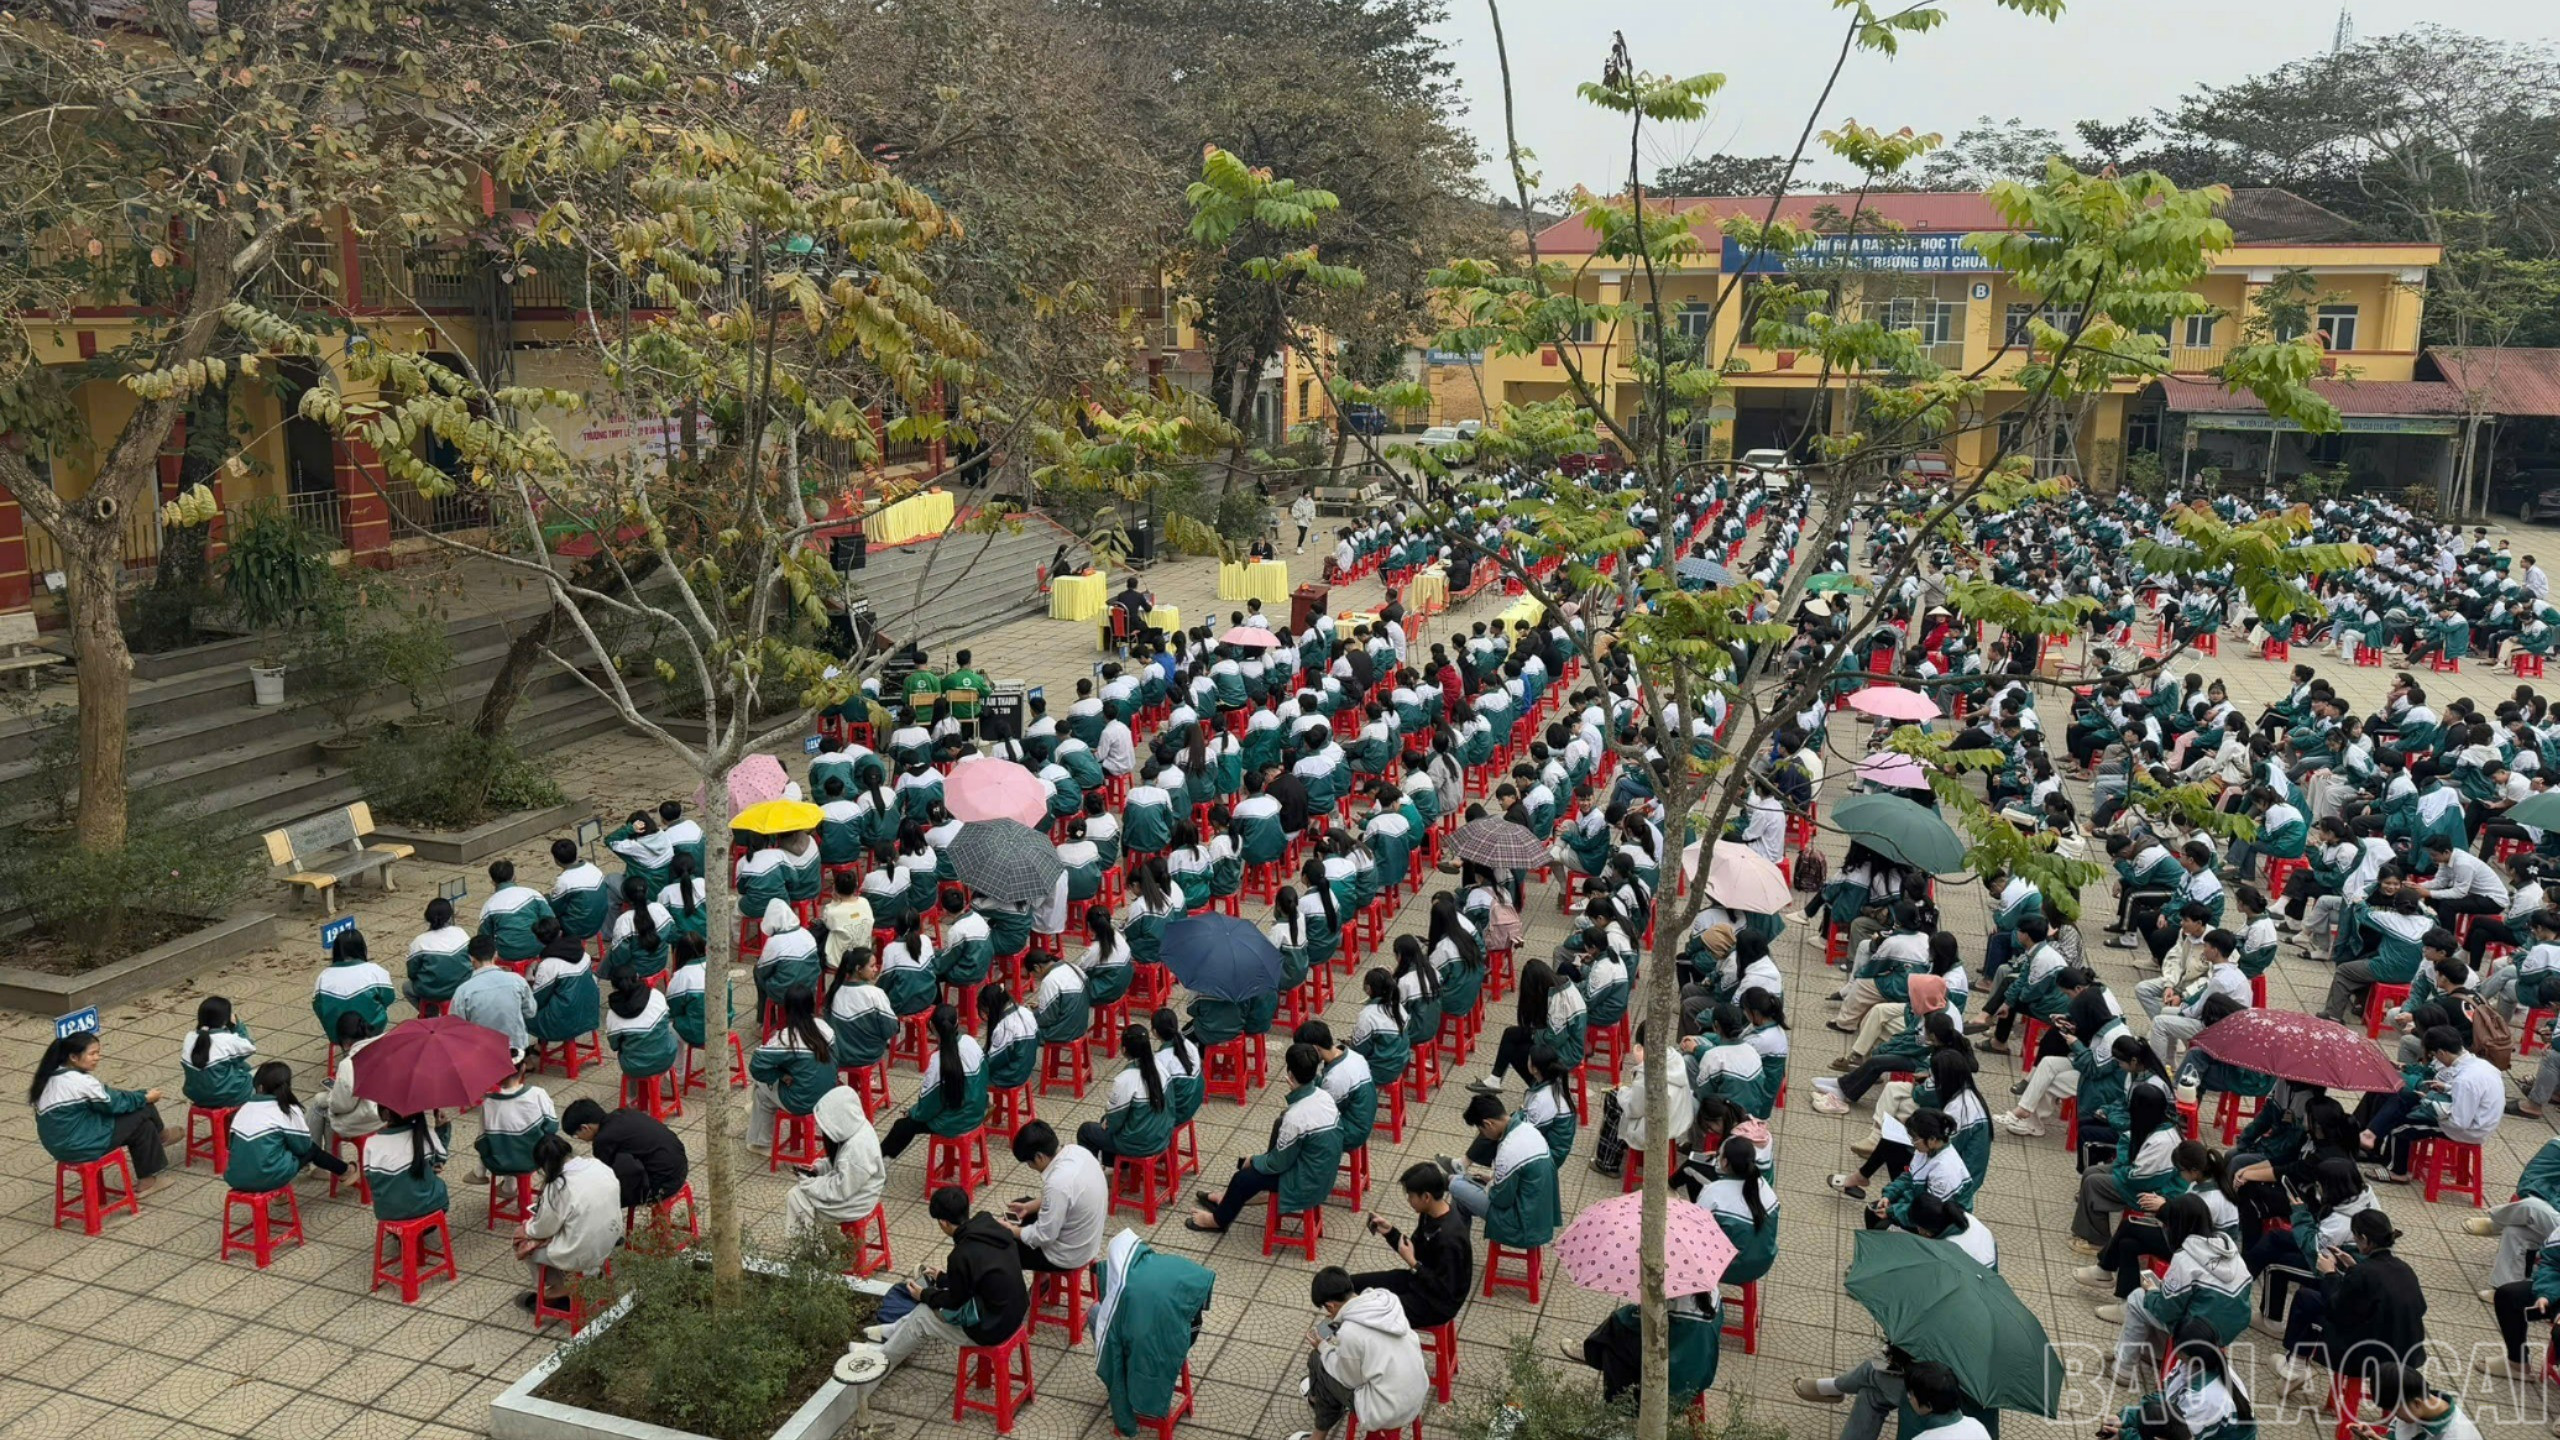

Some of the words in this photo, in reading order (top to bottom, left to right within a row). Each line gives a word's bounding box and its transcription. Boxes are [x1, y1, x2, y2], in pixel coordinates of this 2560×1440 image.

[1920, 237, 1947, 253] HỌC
[1923, 255, 1949, 270] ĐẠT
[1975, 285, 1987, 298] B
[60, 1013, 95, 1039] 12A8
